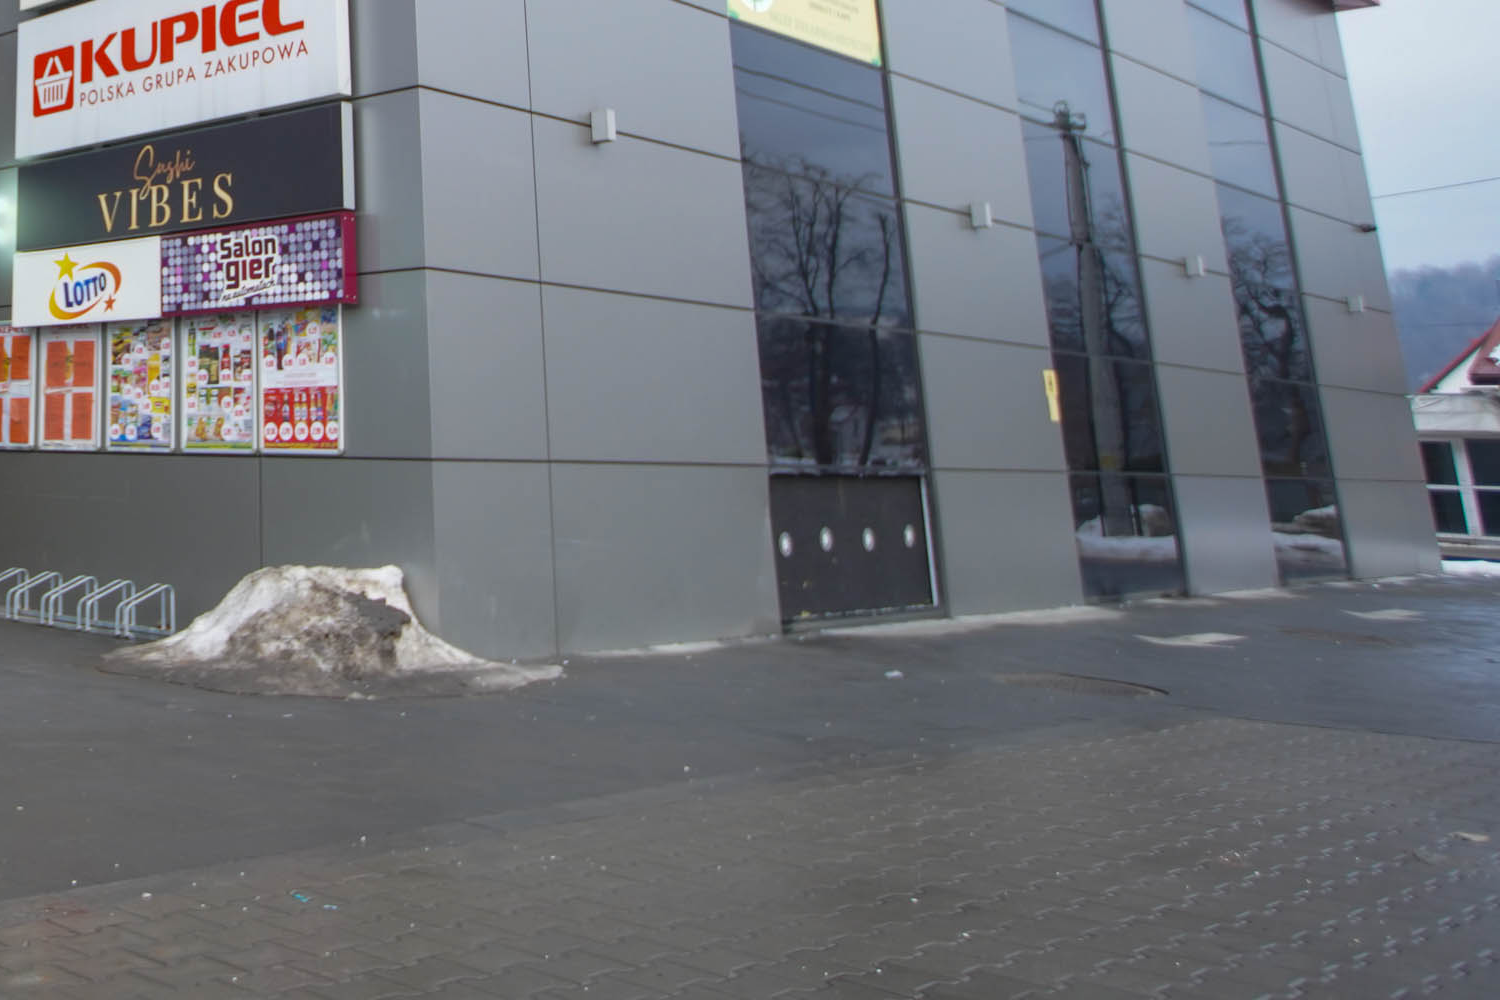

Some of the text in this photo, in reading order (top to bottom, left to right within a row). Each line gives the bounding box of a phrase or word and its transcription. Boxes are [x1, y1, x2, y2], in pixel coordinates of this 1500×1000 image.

[80, 39, 309, 106] POLSKA GRUPA ZAKUPOWA
[133, 145, 195, 200] Sushi
[98, 173, 234, 233] VIBES
[219, 234, 276, 260] Salon
[63, 271, 108, 308] LOTTO
[225, 257, 275, 290] gier
